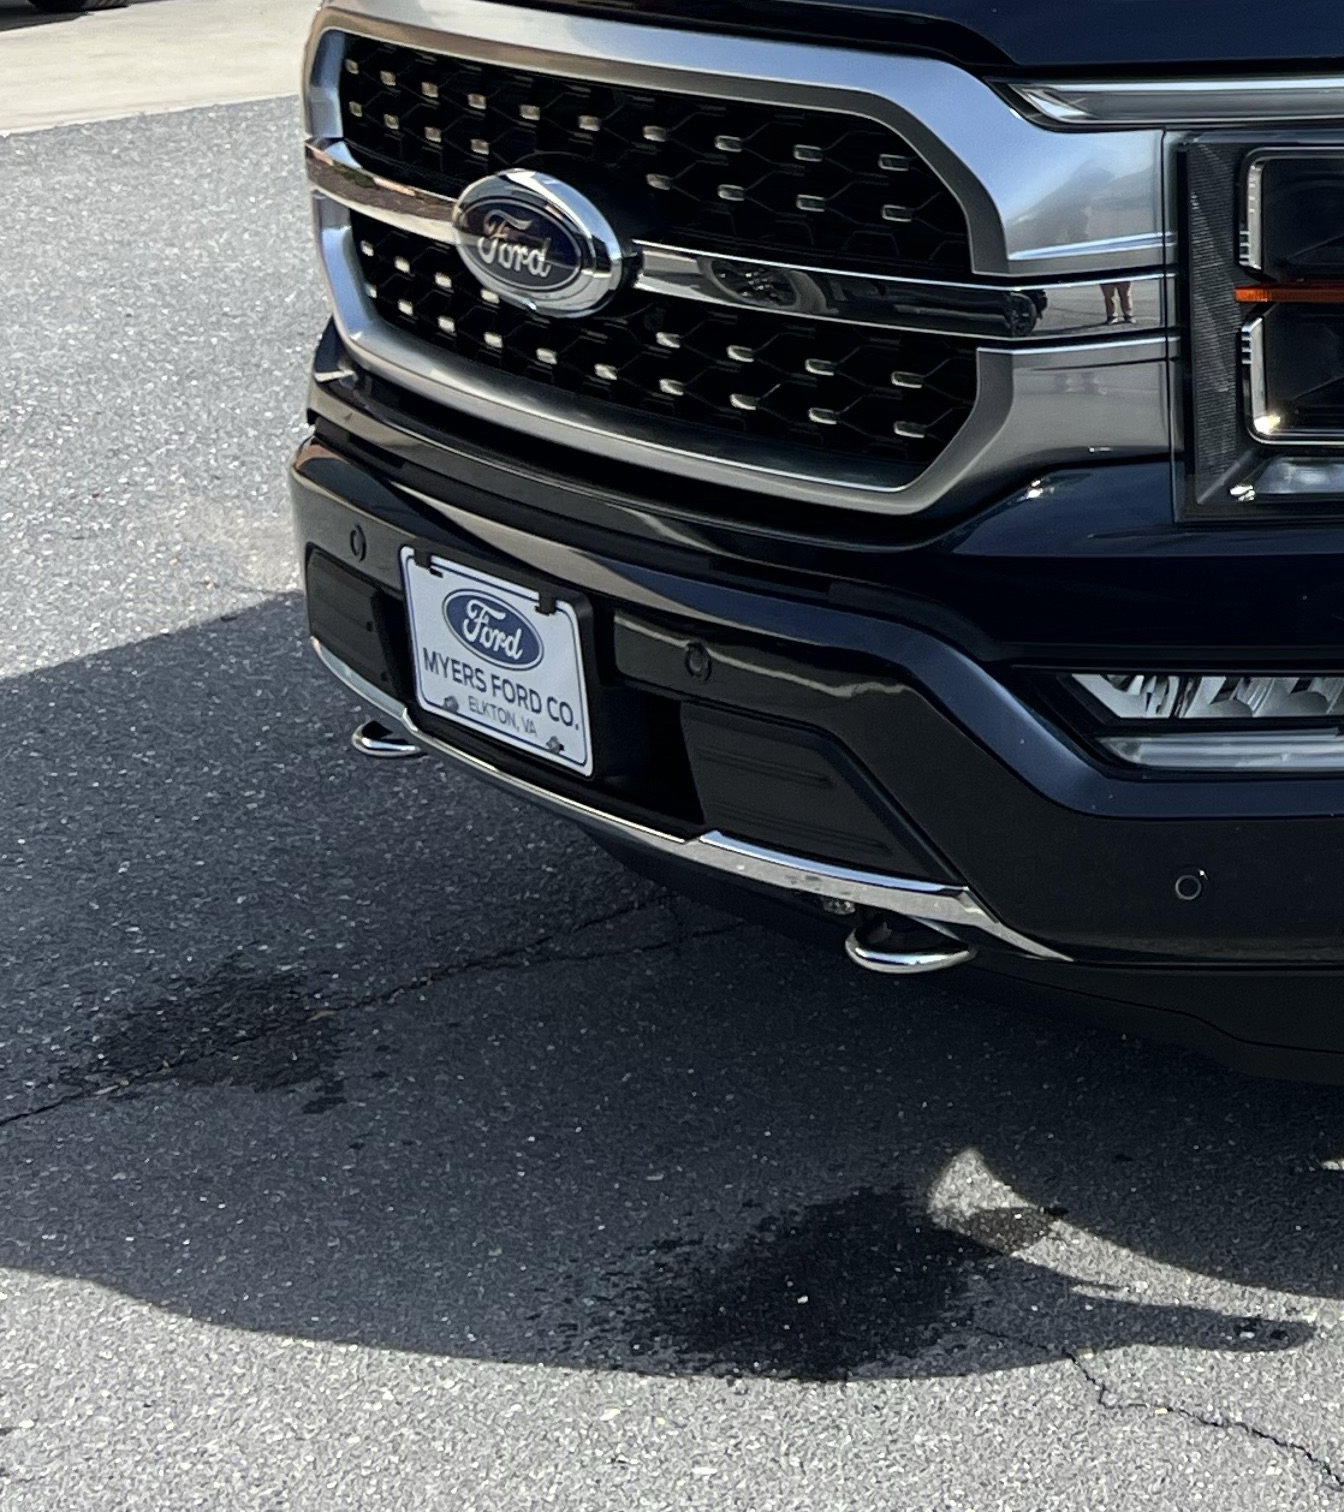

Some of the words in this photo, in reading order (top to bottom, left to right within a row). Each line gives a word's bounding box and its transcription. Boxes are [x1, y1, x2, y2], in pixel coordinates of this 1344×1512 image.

[477, 208, 551, 278] Ford
[463, 599, 524, 661] Ford
[422, 646, 487, 693] MYERS
[490, 673, 542, 715] FORD
[546, 695, 580, 731] CO.
[467, 695, 520, 734] ELKTON,
[521, 716, 538, 738] VA
